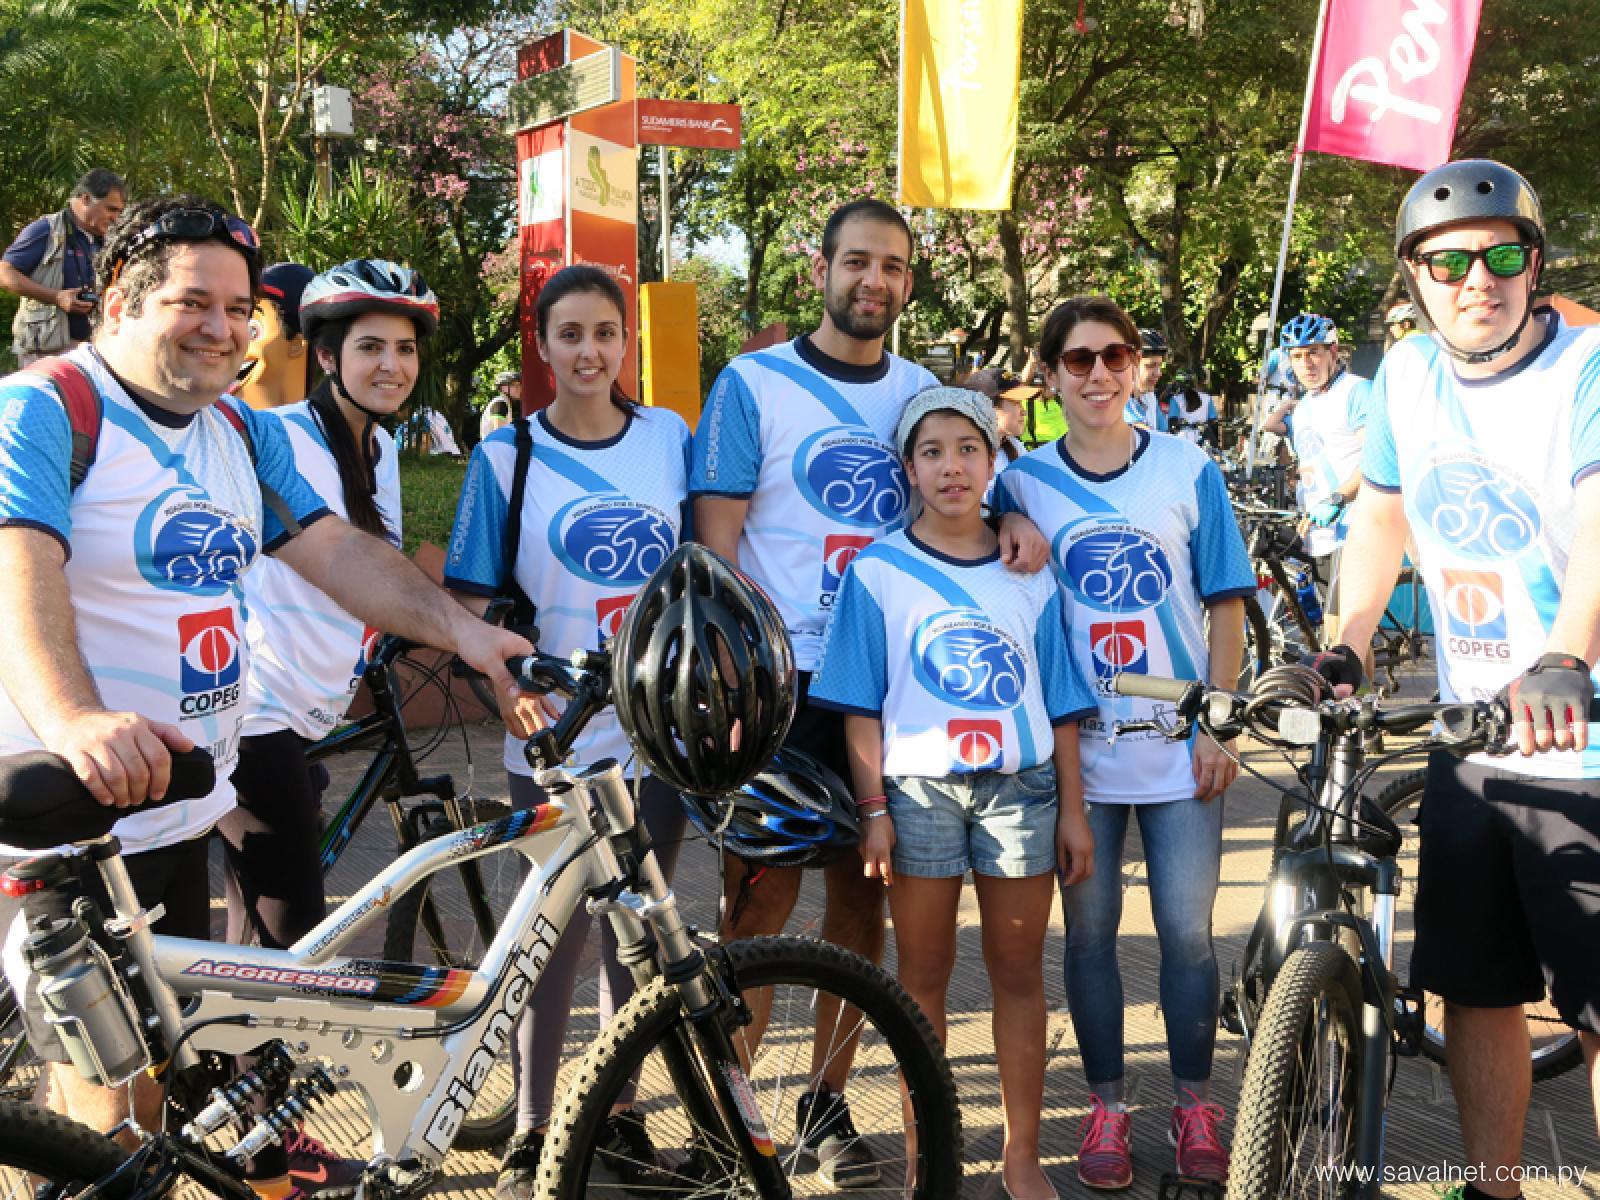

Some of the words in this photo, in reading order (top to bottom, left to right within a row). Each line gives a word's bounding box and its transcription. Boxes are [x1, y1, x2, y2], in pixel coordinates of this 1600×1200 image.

[1449, 637, 1511, 659] COPEG
[183, 960, 380, 993] AGGRESSOR
[424, 913, 561, 1155] Bianchi
